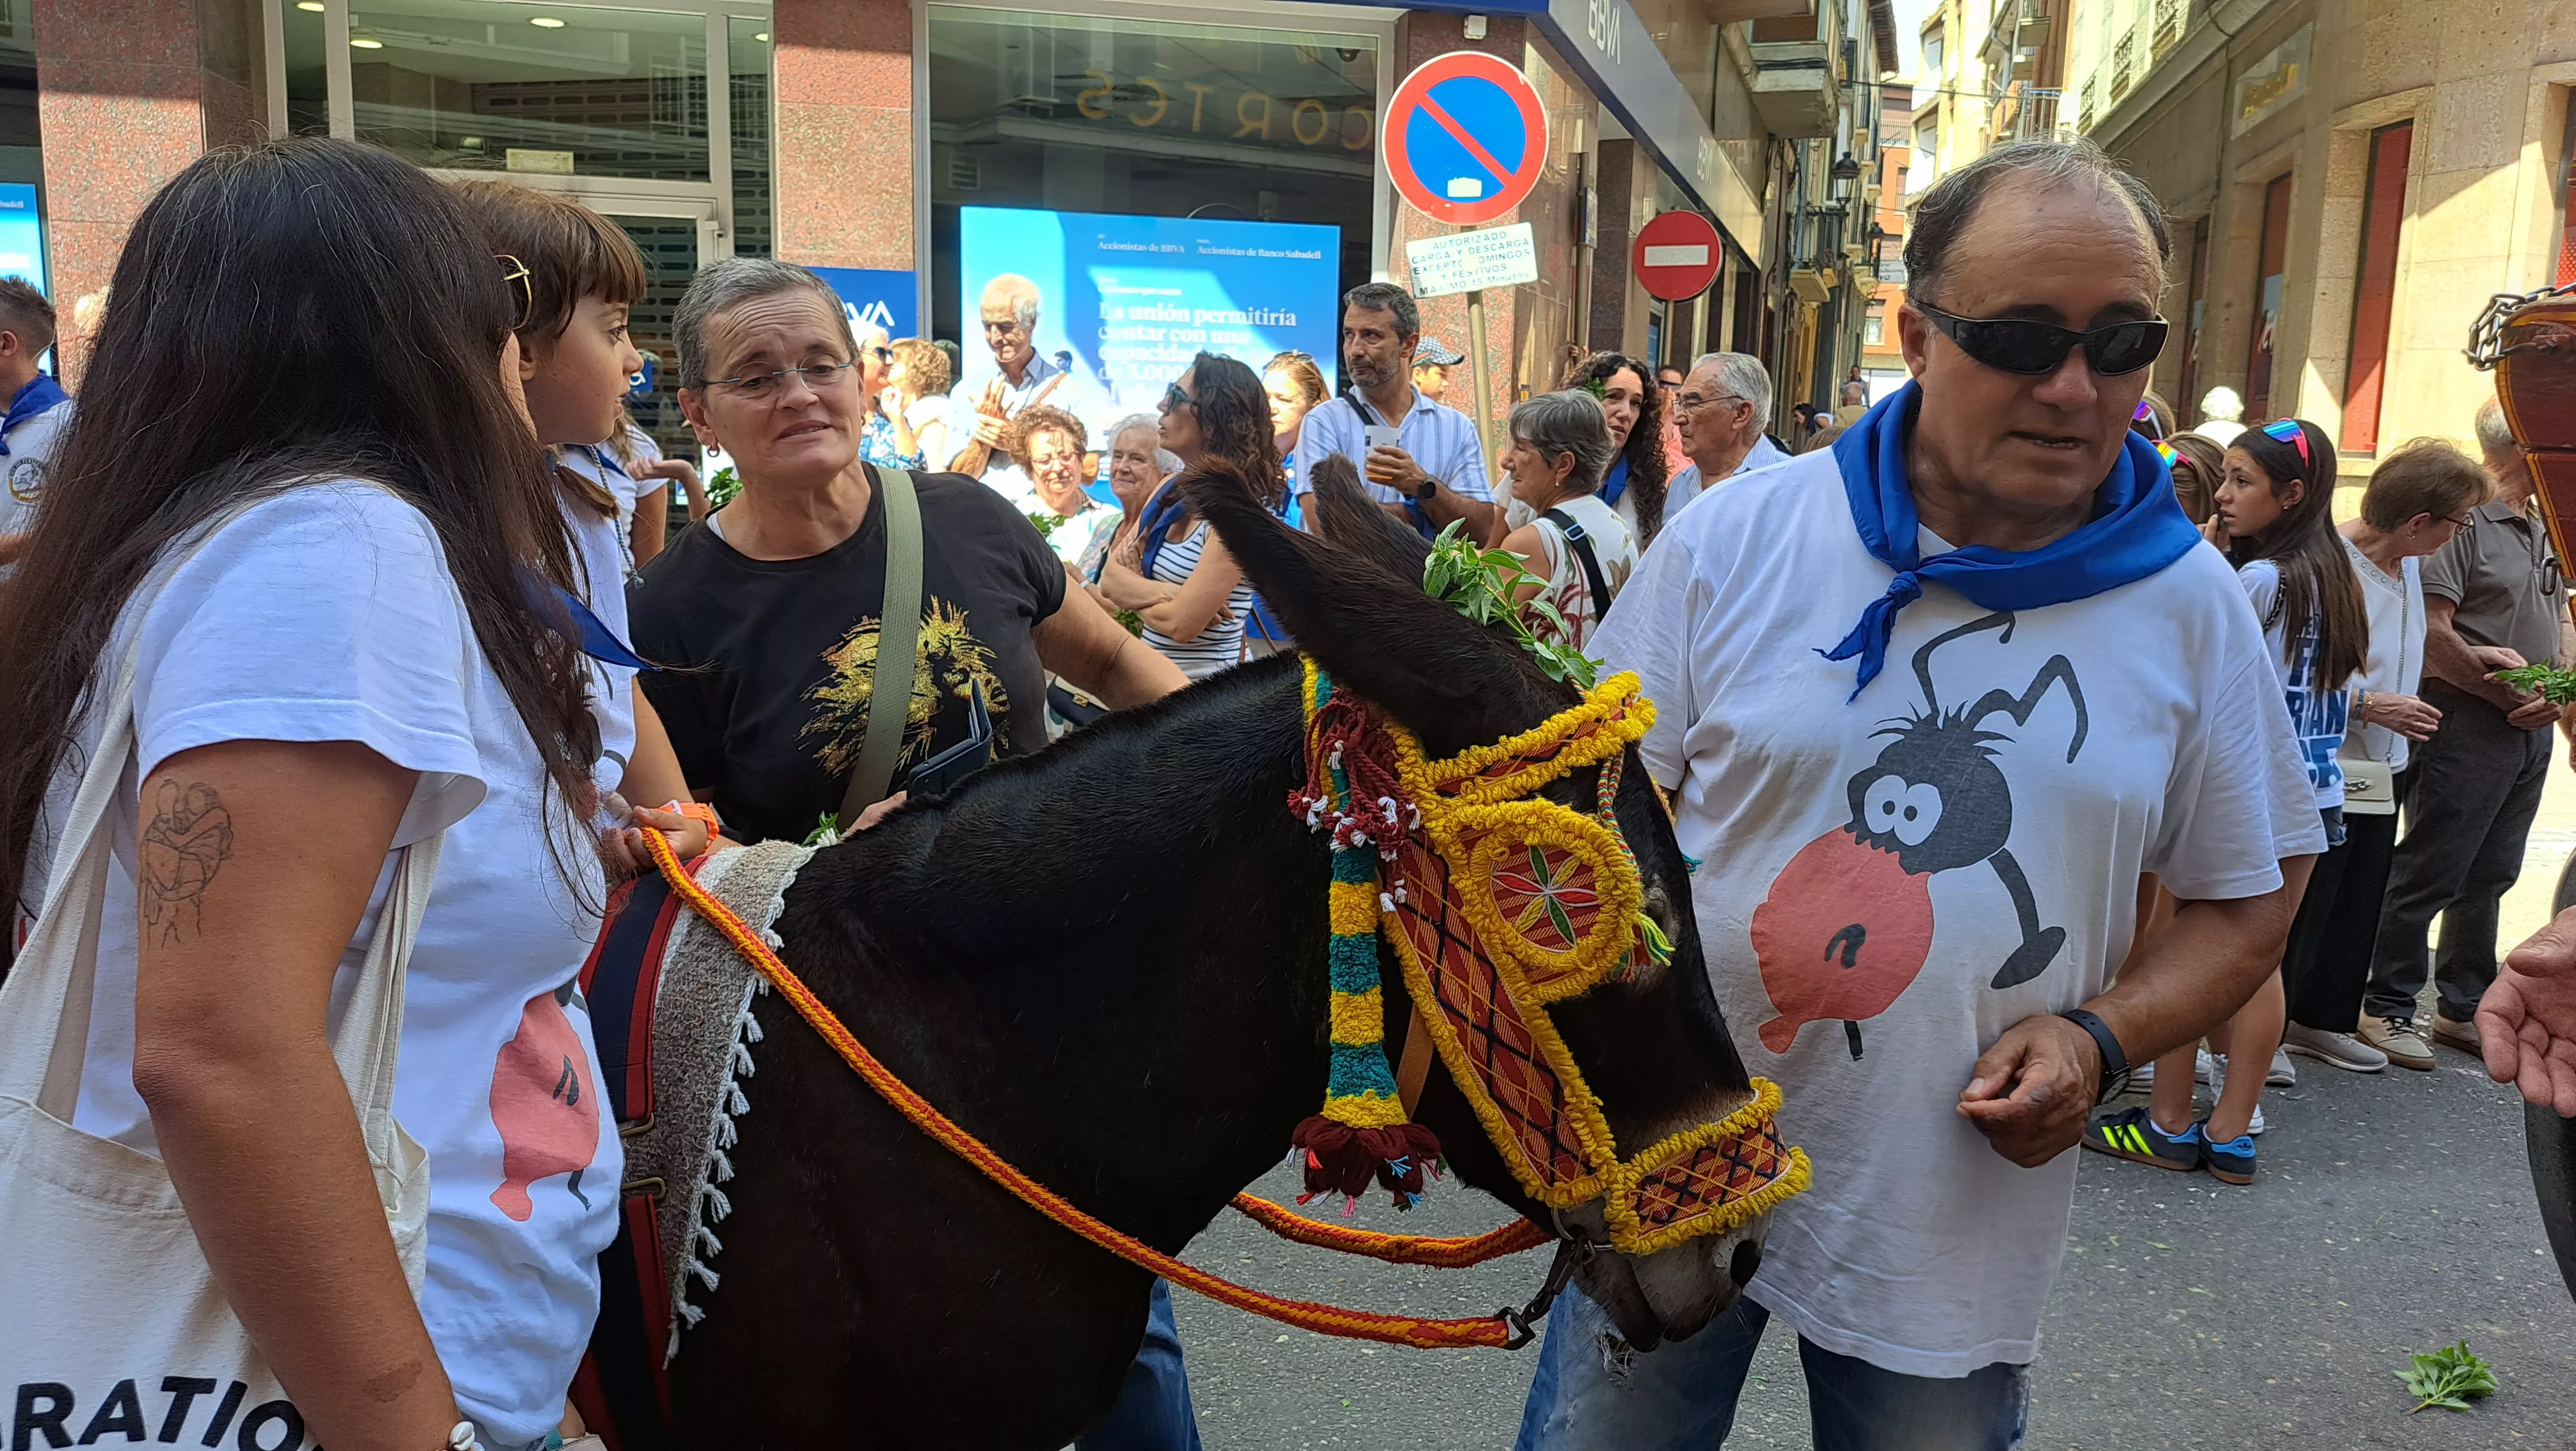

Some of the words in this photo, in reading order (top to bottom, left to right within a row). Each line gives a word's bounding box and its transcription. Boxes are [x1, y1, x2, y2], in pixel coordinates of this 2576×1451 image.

[1588, 0, 1620, 65] BBVA
[1097, 241, 1147, 252] Accionistas
[1148, 243, 1160, 252] de
[1433, 231, 1507, 250] AUTORIZADO
[1197, 245, 1245, 256] Accionistas
[1246, 247, 1257, 256] de
[1258, 249, 1285, 257] Banco
[1285, 250, 1321, 259] Sabadell
[1412, 251, 1451, 265] CARGA
[1468, 238, 1529, 255] DESCARGA
[1478, 249, 1530, 264] OMINGOS
[1128, 302, 1191, 323] unión
[1193, 306, 1297, 327] permitiría
[1097, 325, 1167, 342] contar
[1168, 328, 1207, 343] con
[1209, 331, 1250, 344] una
[0, 1376, 324, 1451] RATIO
